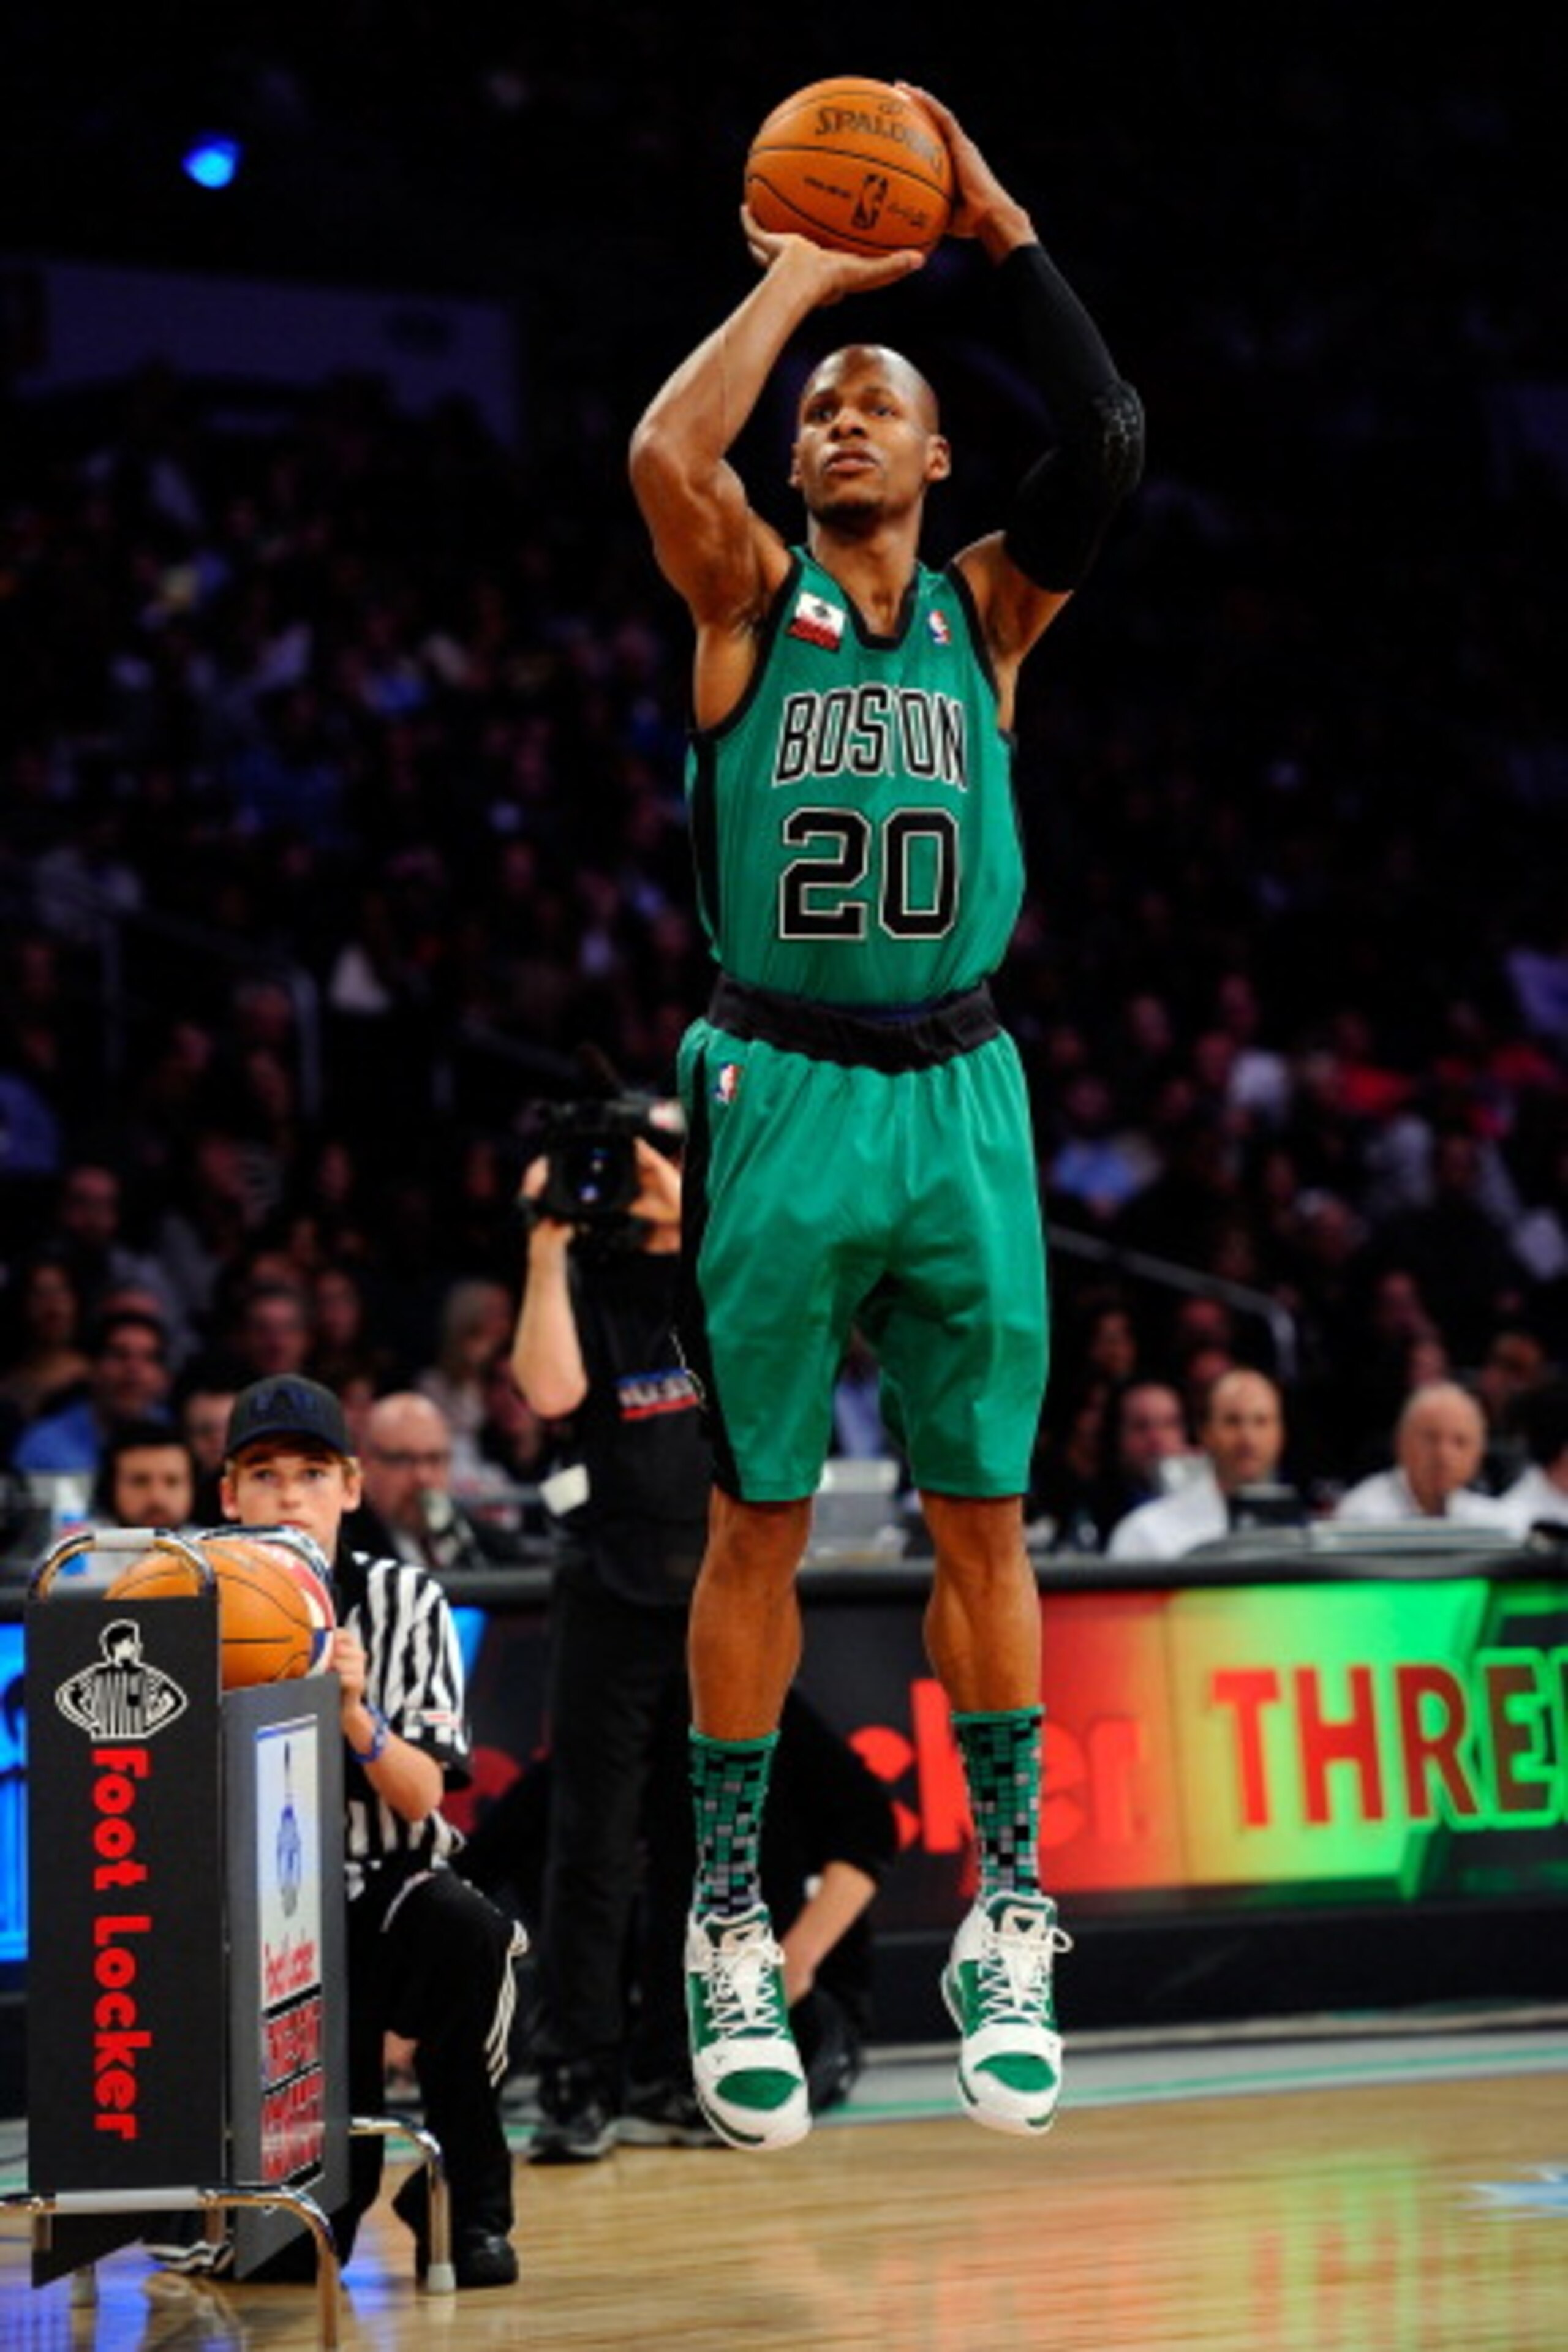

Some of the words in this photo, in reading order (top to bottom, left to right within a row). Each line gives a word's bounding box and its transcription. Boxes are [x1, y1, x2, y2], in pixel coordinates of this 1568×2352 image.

[772, 684, 967, 793] BOSON
[779, 807, 959, 940] 20
[1210, 1661, 1568, 1828] THRE
[92, 1747, 151, 1891] Foot
[94, 1916, 153, 2140] Locker
